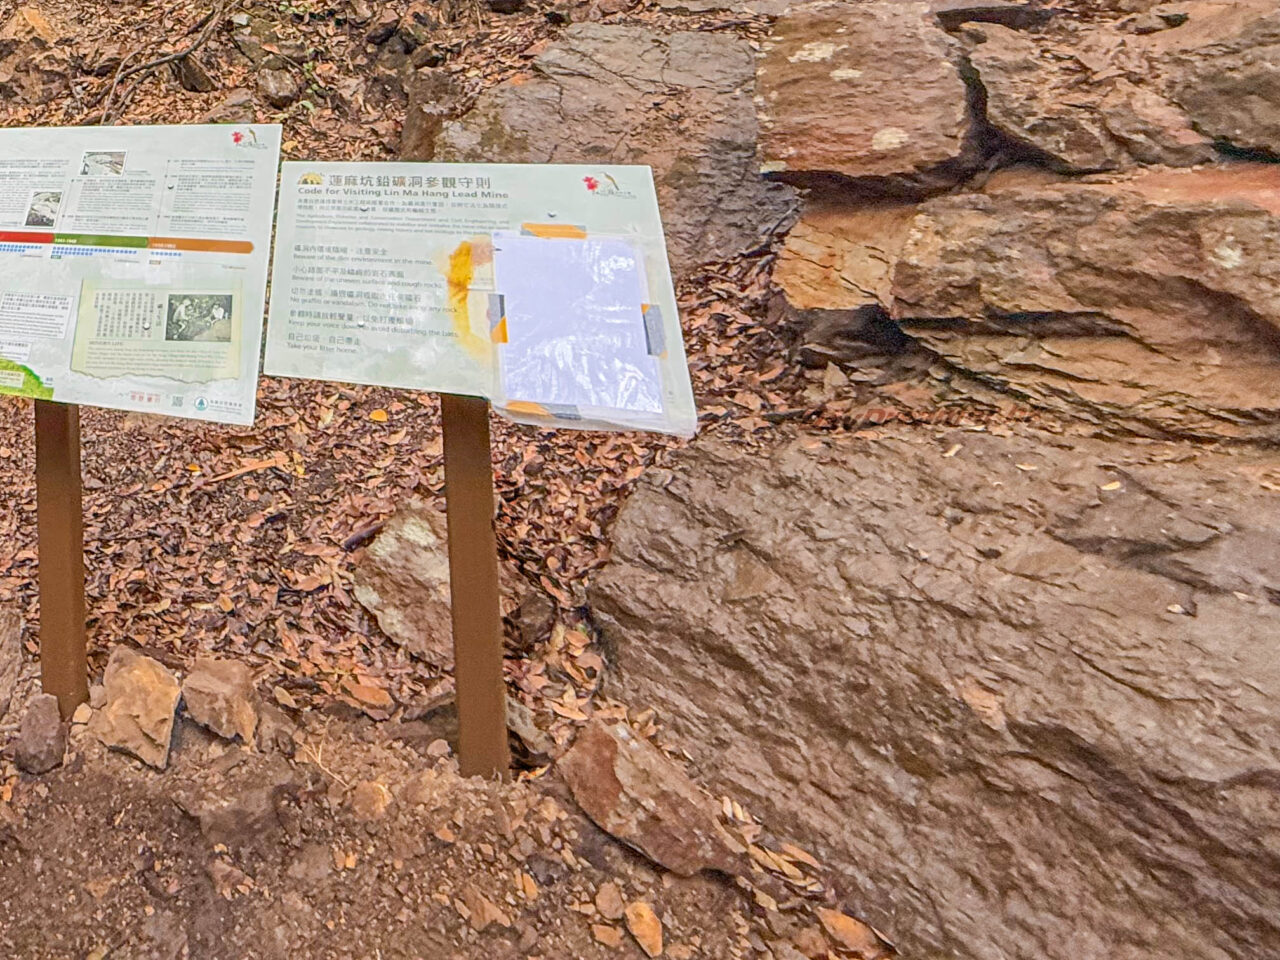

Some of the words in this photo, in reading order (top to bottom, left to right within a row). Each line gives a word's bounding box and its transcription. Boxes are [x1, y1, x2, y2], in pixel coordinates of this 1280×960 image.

[297, 187, 323, 195] Code
[325, 187, 340, 195] for
[342, 188, 381, 197] Visiting
[402, 189, 419, 197] Ma
[421, 190, 449, 199] Hang
